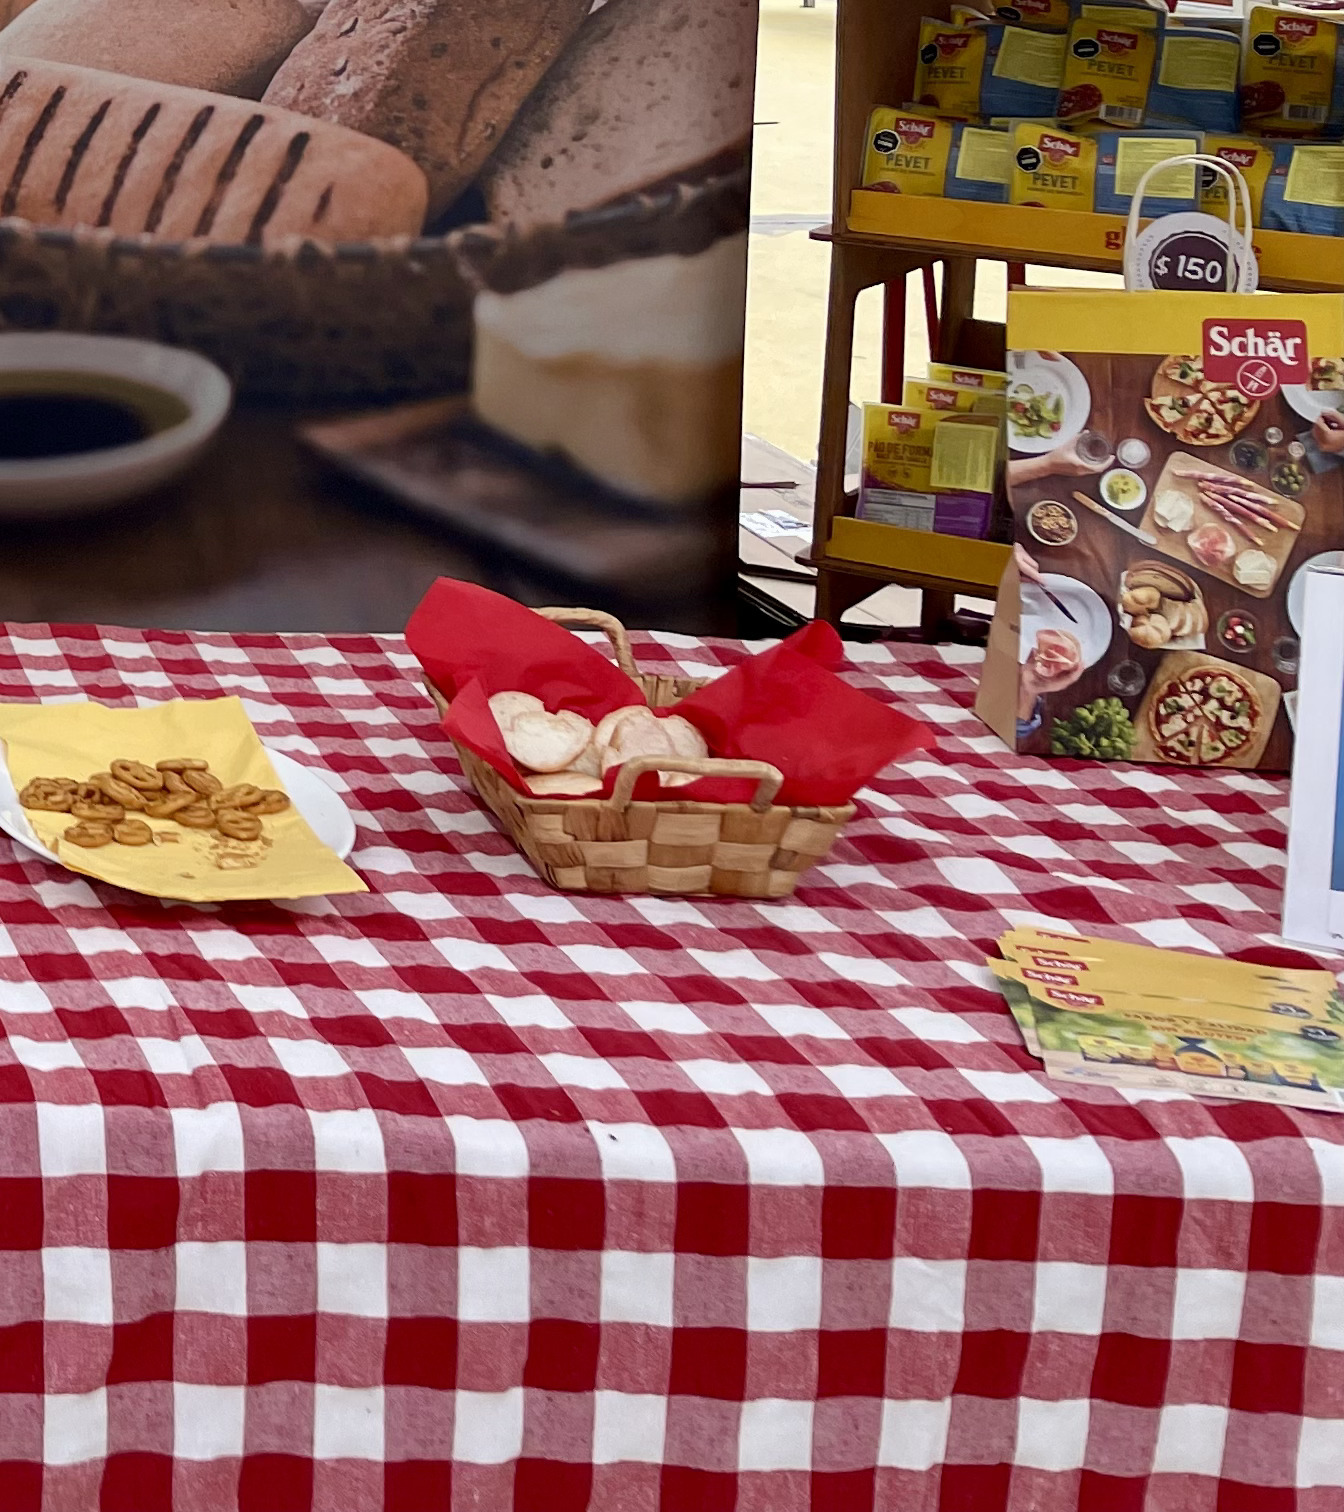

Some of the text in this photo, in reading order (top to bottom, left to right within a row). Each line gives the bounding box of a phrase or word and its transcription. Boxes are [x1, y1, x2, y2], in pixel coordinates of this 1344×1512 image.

[1086, 59, 1135, 77] PEVET
[1032, 173, 1079, 190] PEVET
[1154, 254, 1222, 284] $ 150
[1209, 324, 1303, 367] Schär
